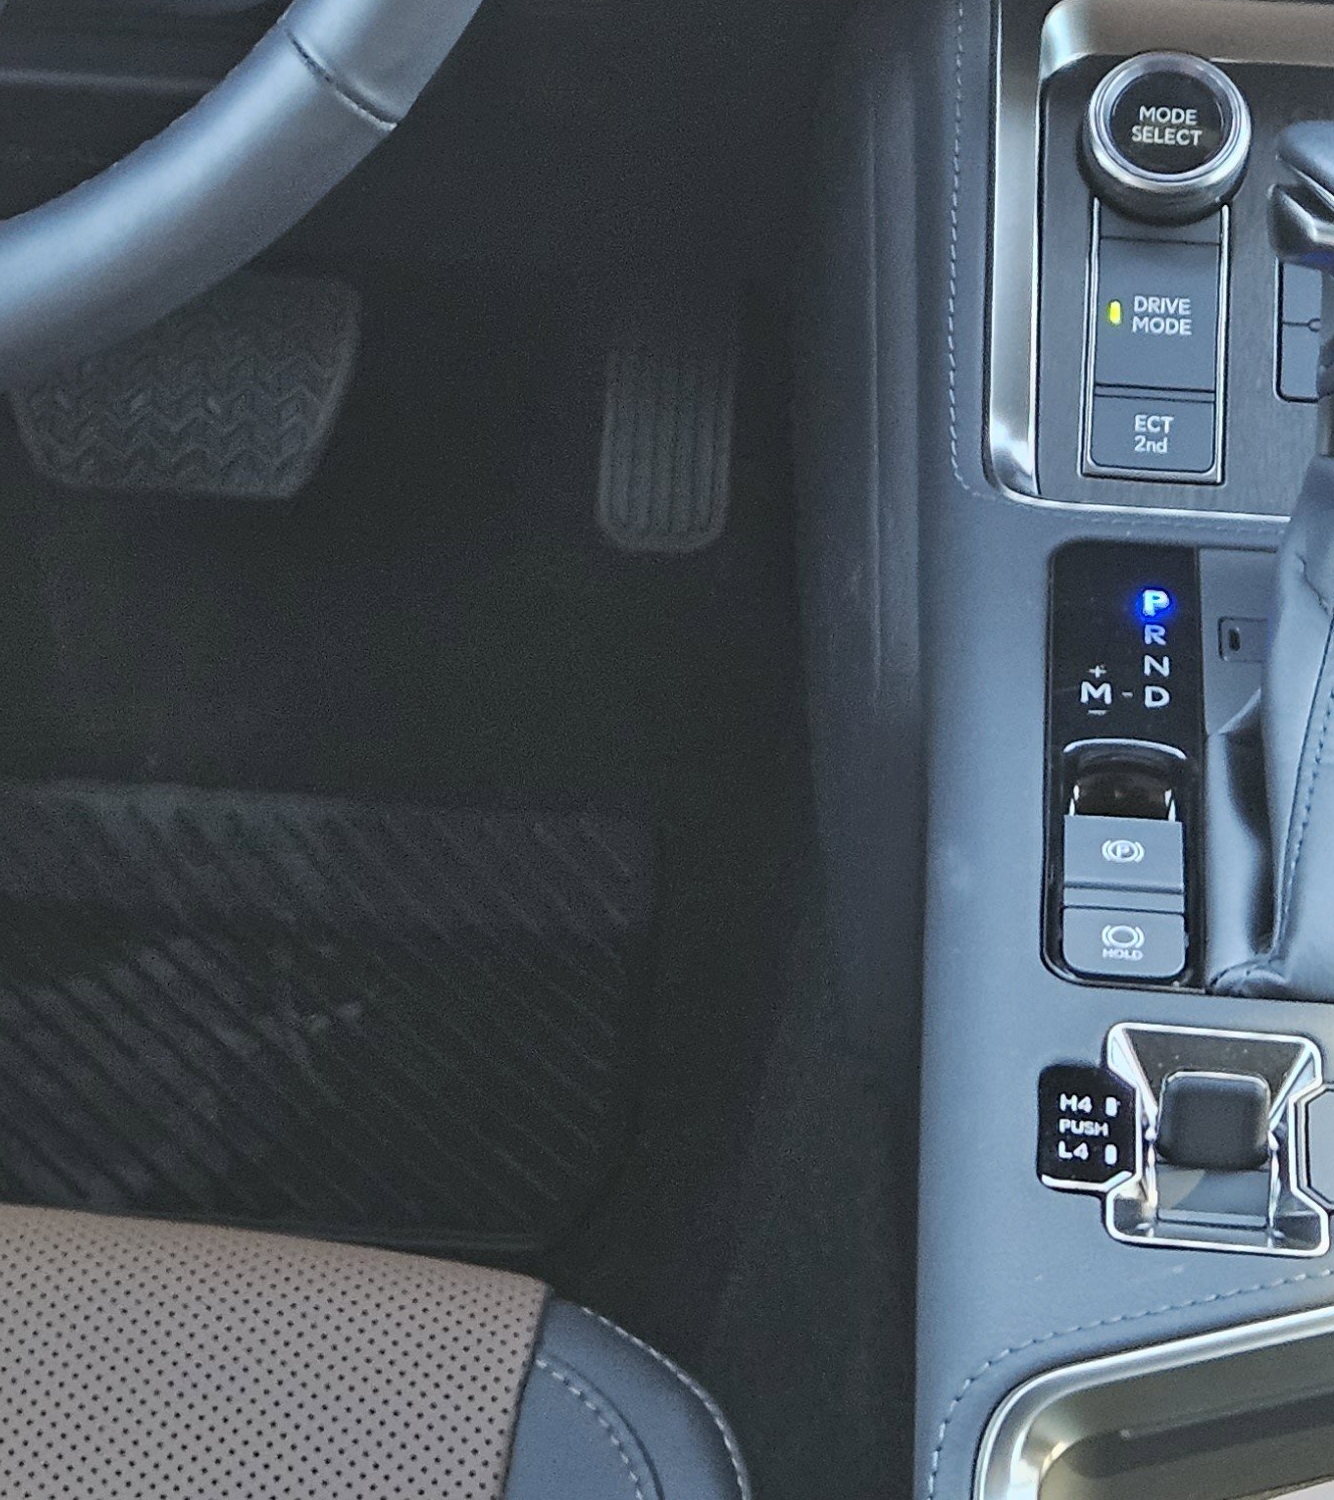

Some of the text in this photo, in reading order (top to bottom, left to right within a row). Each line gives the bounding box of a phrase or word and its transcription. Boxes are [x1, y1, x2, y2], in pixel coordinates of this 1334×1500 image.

[1139, 104, 1198, 127] MODE
[1131, 124, 1203, 148] SELECT
[1132, 295, 1192, 316] DRIVE
[1131, 314, 1193, 336] MODE
[1133, 413, 1174, 435] ECT
[1133, 434, 1169, 455] 2nd
[1142, 589, 1170, 618] P
[1144, 623, 1167, 647] R
[1144, 655, 1171, 678] N
[1080, 680, 1113, 706] M
[1144, 685, 1171, 710] D
[1101, 947, 1144, 962] HOLD
[1058, 1093, 1093, 1114] H4
[1058, 1118, 1110, 1138] PUSH
[1057, 1141, 1089, 1162] L4
